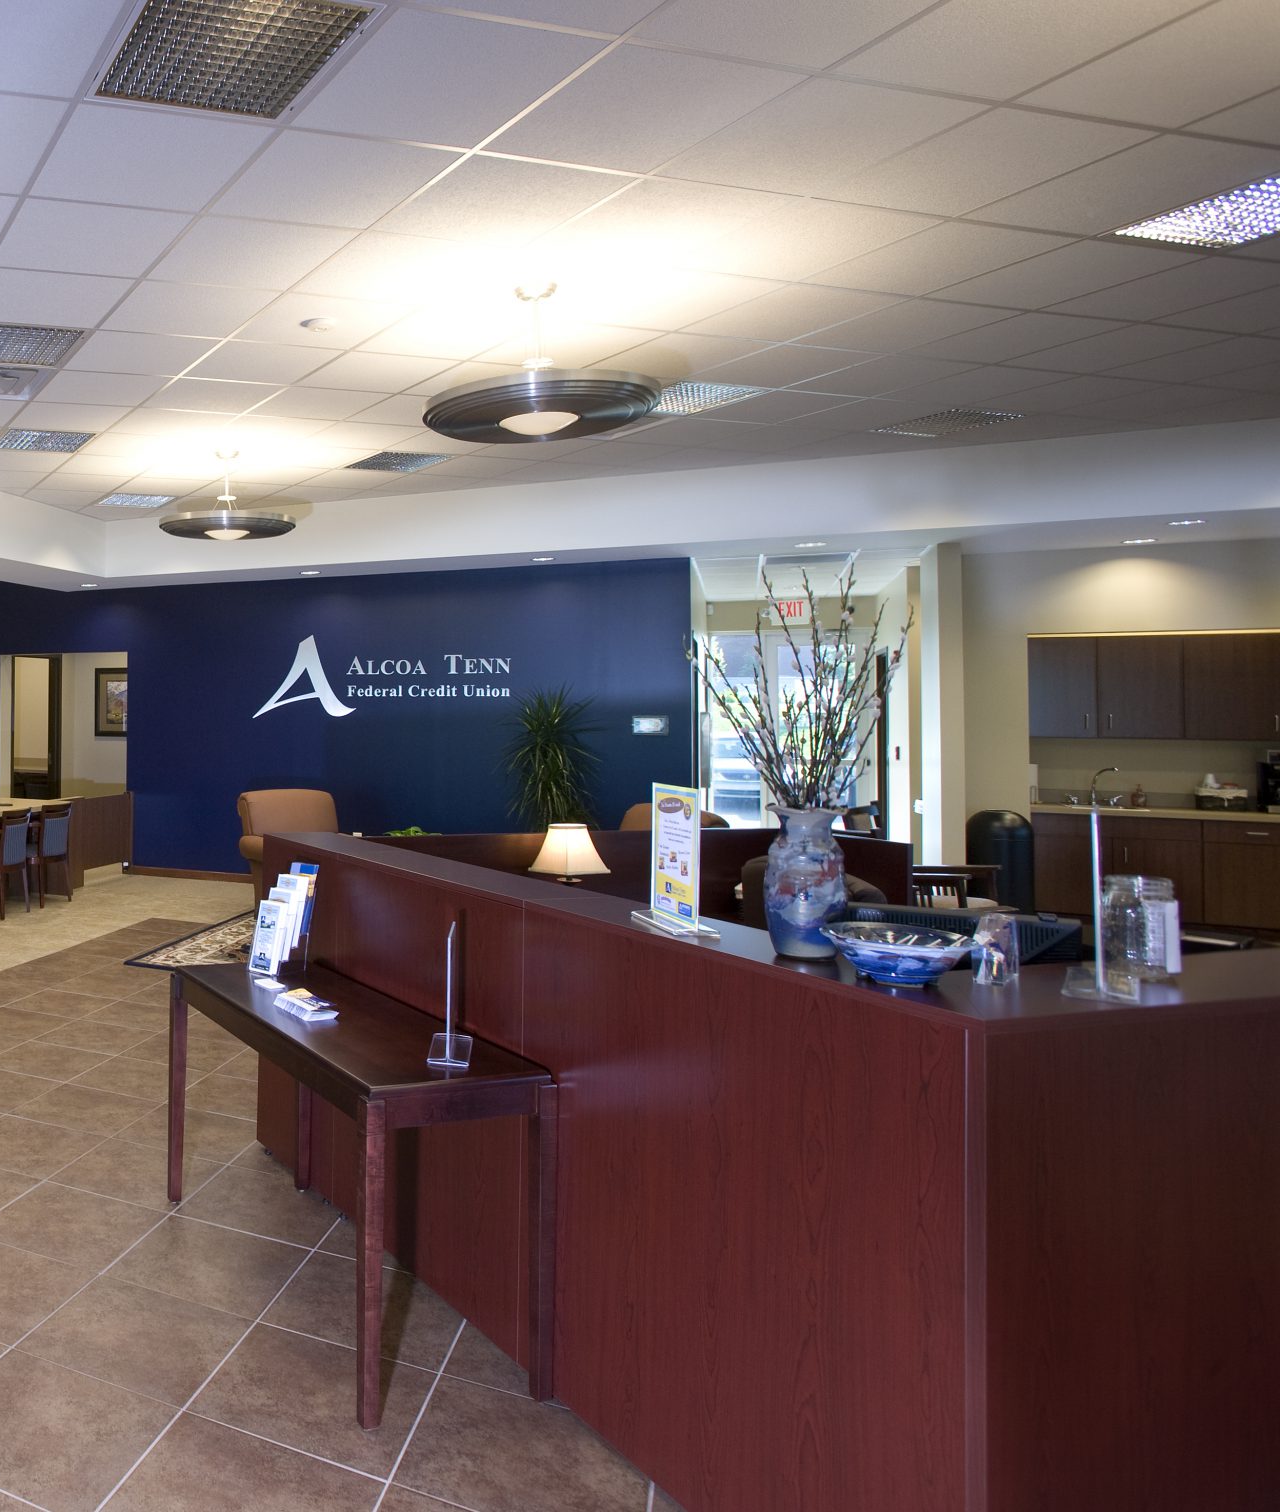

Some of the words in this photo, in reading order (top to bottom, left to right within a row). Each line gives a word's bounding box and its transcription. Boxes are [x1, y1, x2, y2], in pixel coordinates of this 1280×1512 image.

[778, 601, 804, 618] EXIT
[346, 655, 428, 675] ALCOA
[443, 654, 512, 675] TENN
[347, 685, 403, 698] Federal
[408, 685, 458, 698] Credit
[463, 685, 511, 698] Union
